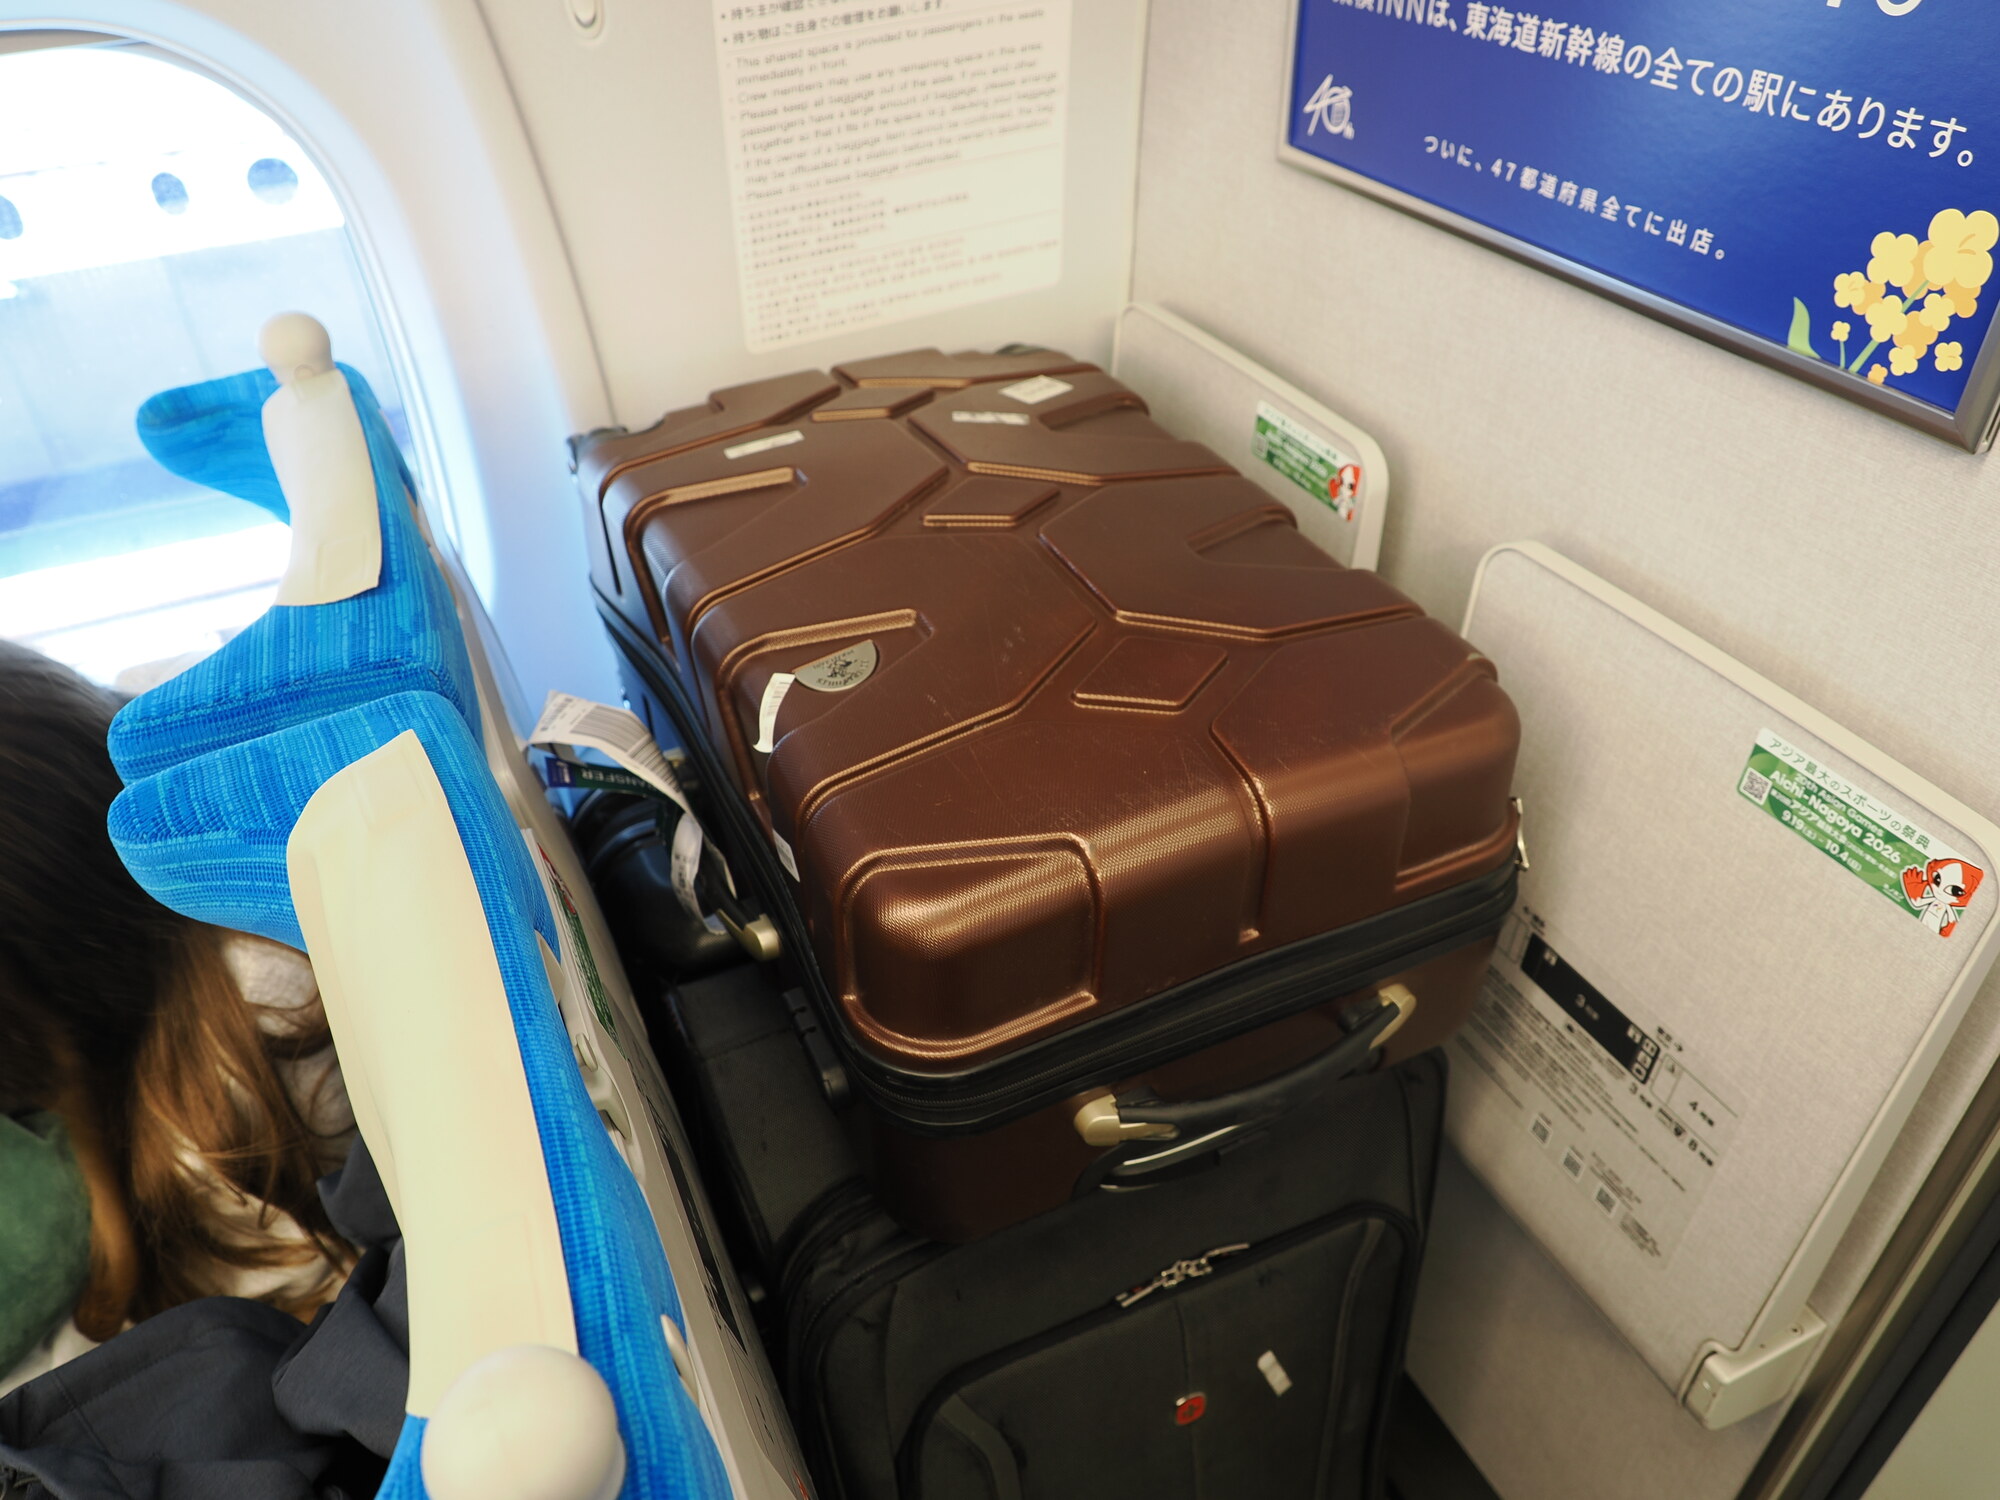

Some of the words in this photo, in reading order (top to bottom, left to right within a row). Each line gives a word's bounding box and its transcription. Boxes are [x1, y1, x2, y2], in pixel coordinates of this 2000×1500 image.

[1332, 0, 1974, 167] INNは、東海道新幹線の全ての駅にあります。
[1423, 135, 1726, 261] ついに、47都道府県全てに出店。
[1769, 738, 1931, 850] アジア最大のスポーツの祭典
[1769, 770, 1863, 838] Aichi-Nagoya
[1862, 832, 1901, 863] 2026
